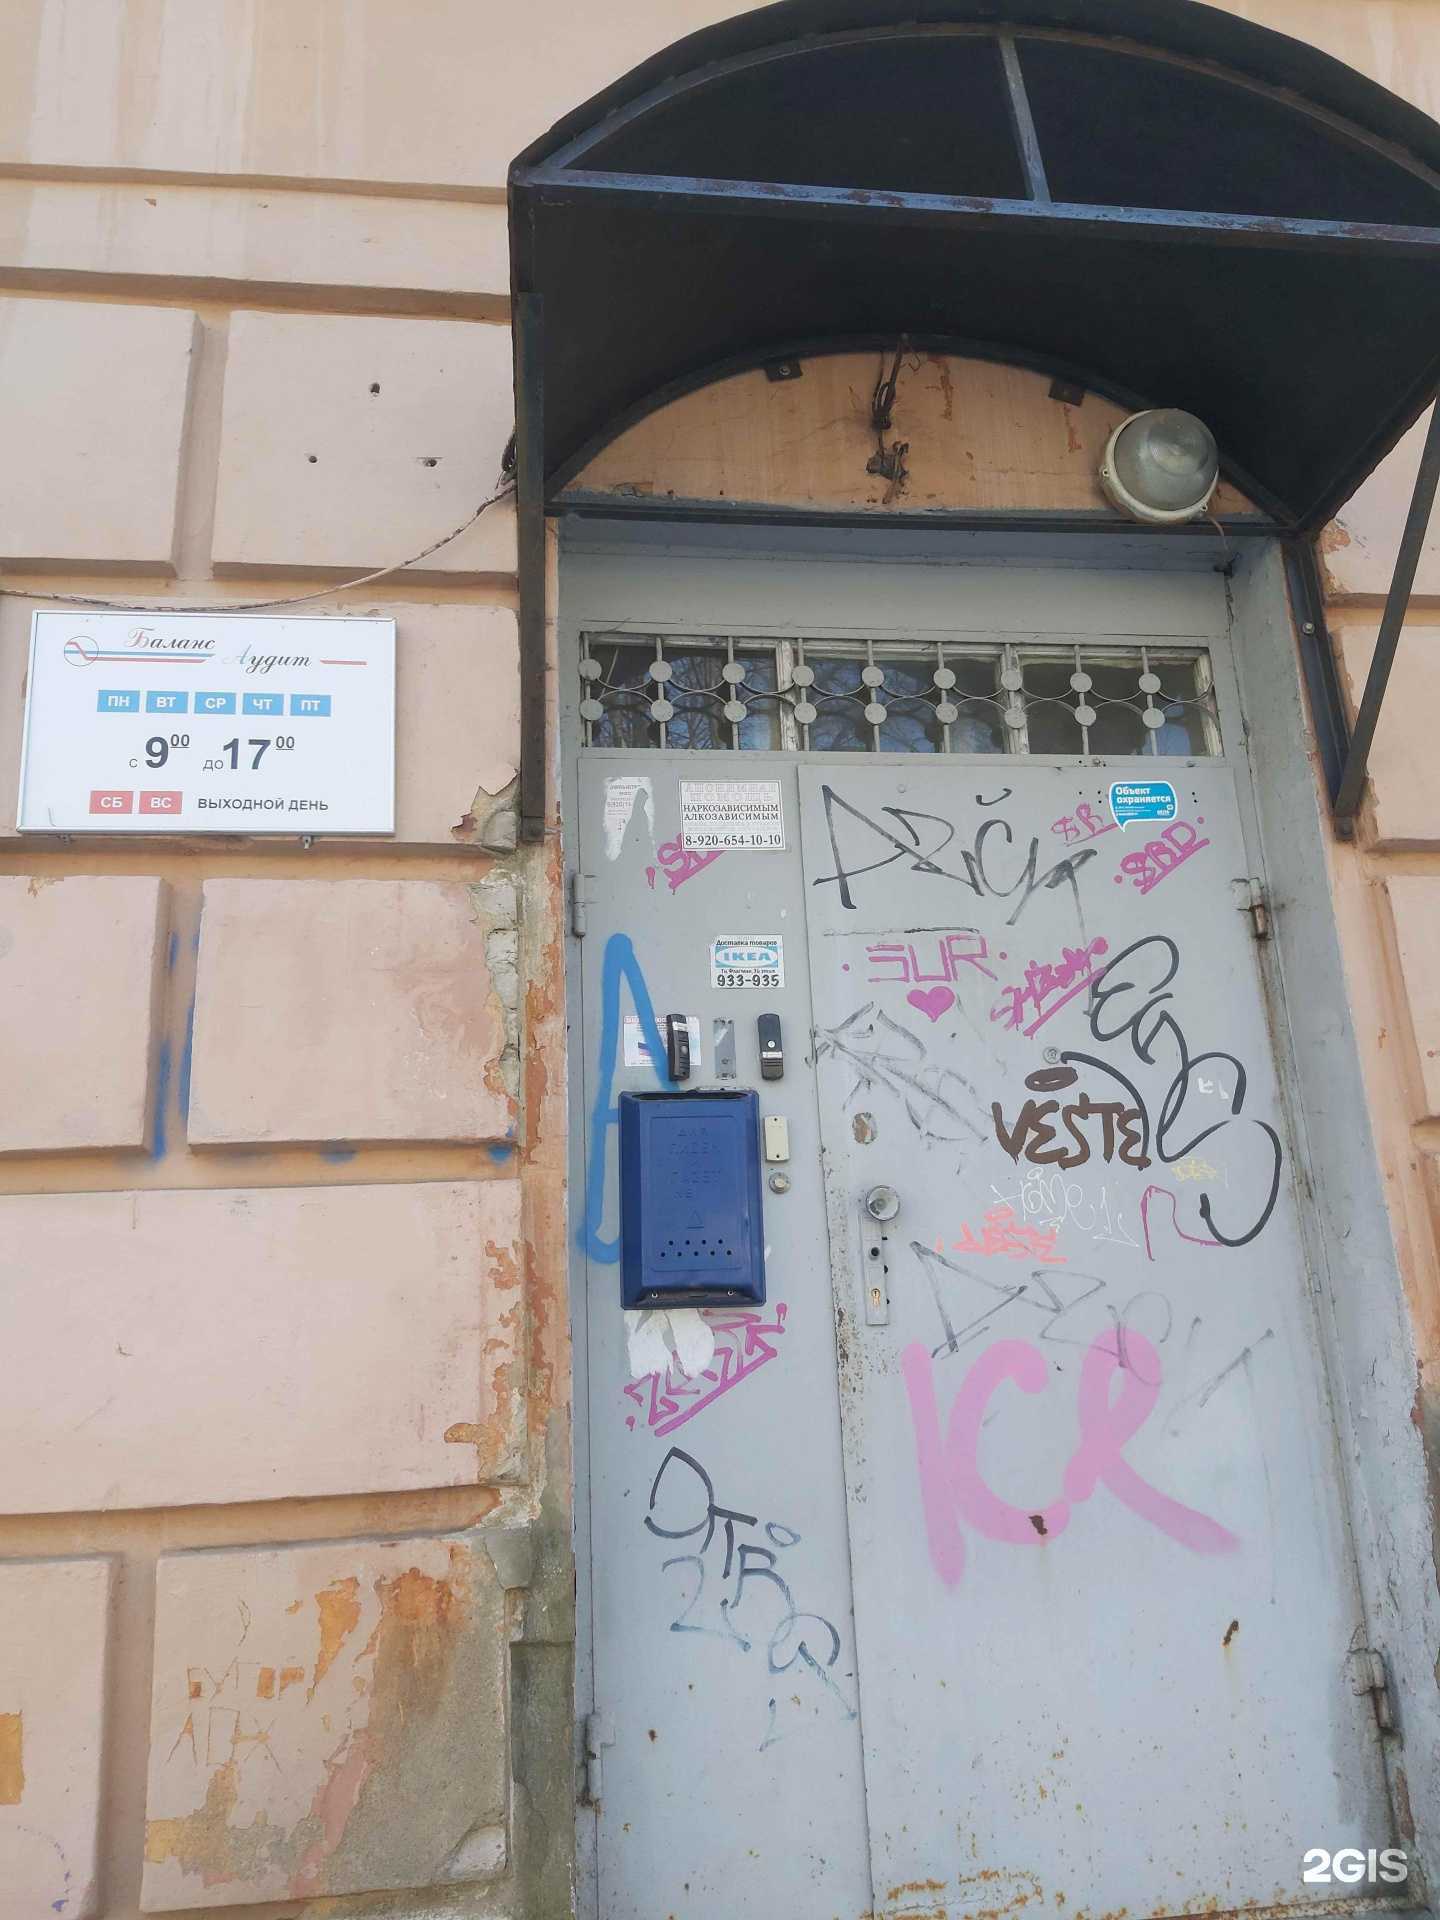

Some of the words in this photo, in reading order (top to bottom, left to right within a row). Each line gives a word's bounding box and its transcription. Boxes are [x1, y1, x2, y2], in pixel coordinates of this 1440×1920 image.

[125, 627, 216, 650] Баланс
[223, 643, 313, 675] Аудит
[107, 695, 130, 708] ПН
[155, 696, 177, 708] ВТ
[204, 697, 227, 710] СР
[252, 698, 273, 711] ЧТ
[300, 699, 321, 712] ПТ
[1115, 786, 1151, 796] Объект
[99, 796, 124, 809] СБ
[149, 796, 173, 809] ВС
[197, 797, 285, 812] ВЫХОДНОЙ
[288, 799, 329, 812] ДЕНЬ
[1116, 795, 1172, 806] охраняется
[682, 803, 780, 813] НАРКОЗАВИСИМЫМ
[683, 813, 780, 821] АЛКОЗАВИСИМЫМ
[684, 834, 781, 847] 8-920-654-10-10
[723, 952, 772, 961] IKEA
[716, 974, 780, 987] 933-935
